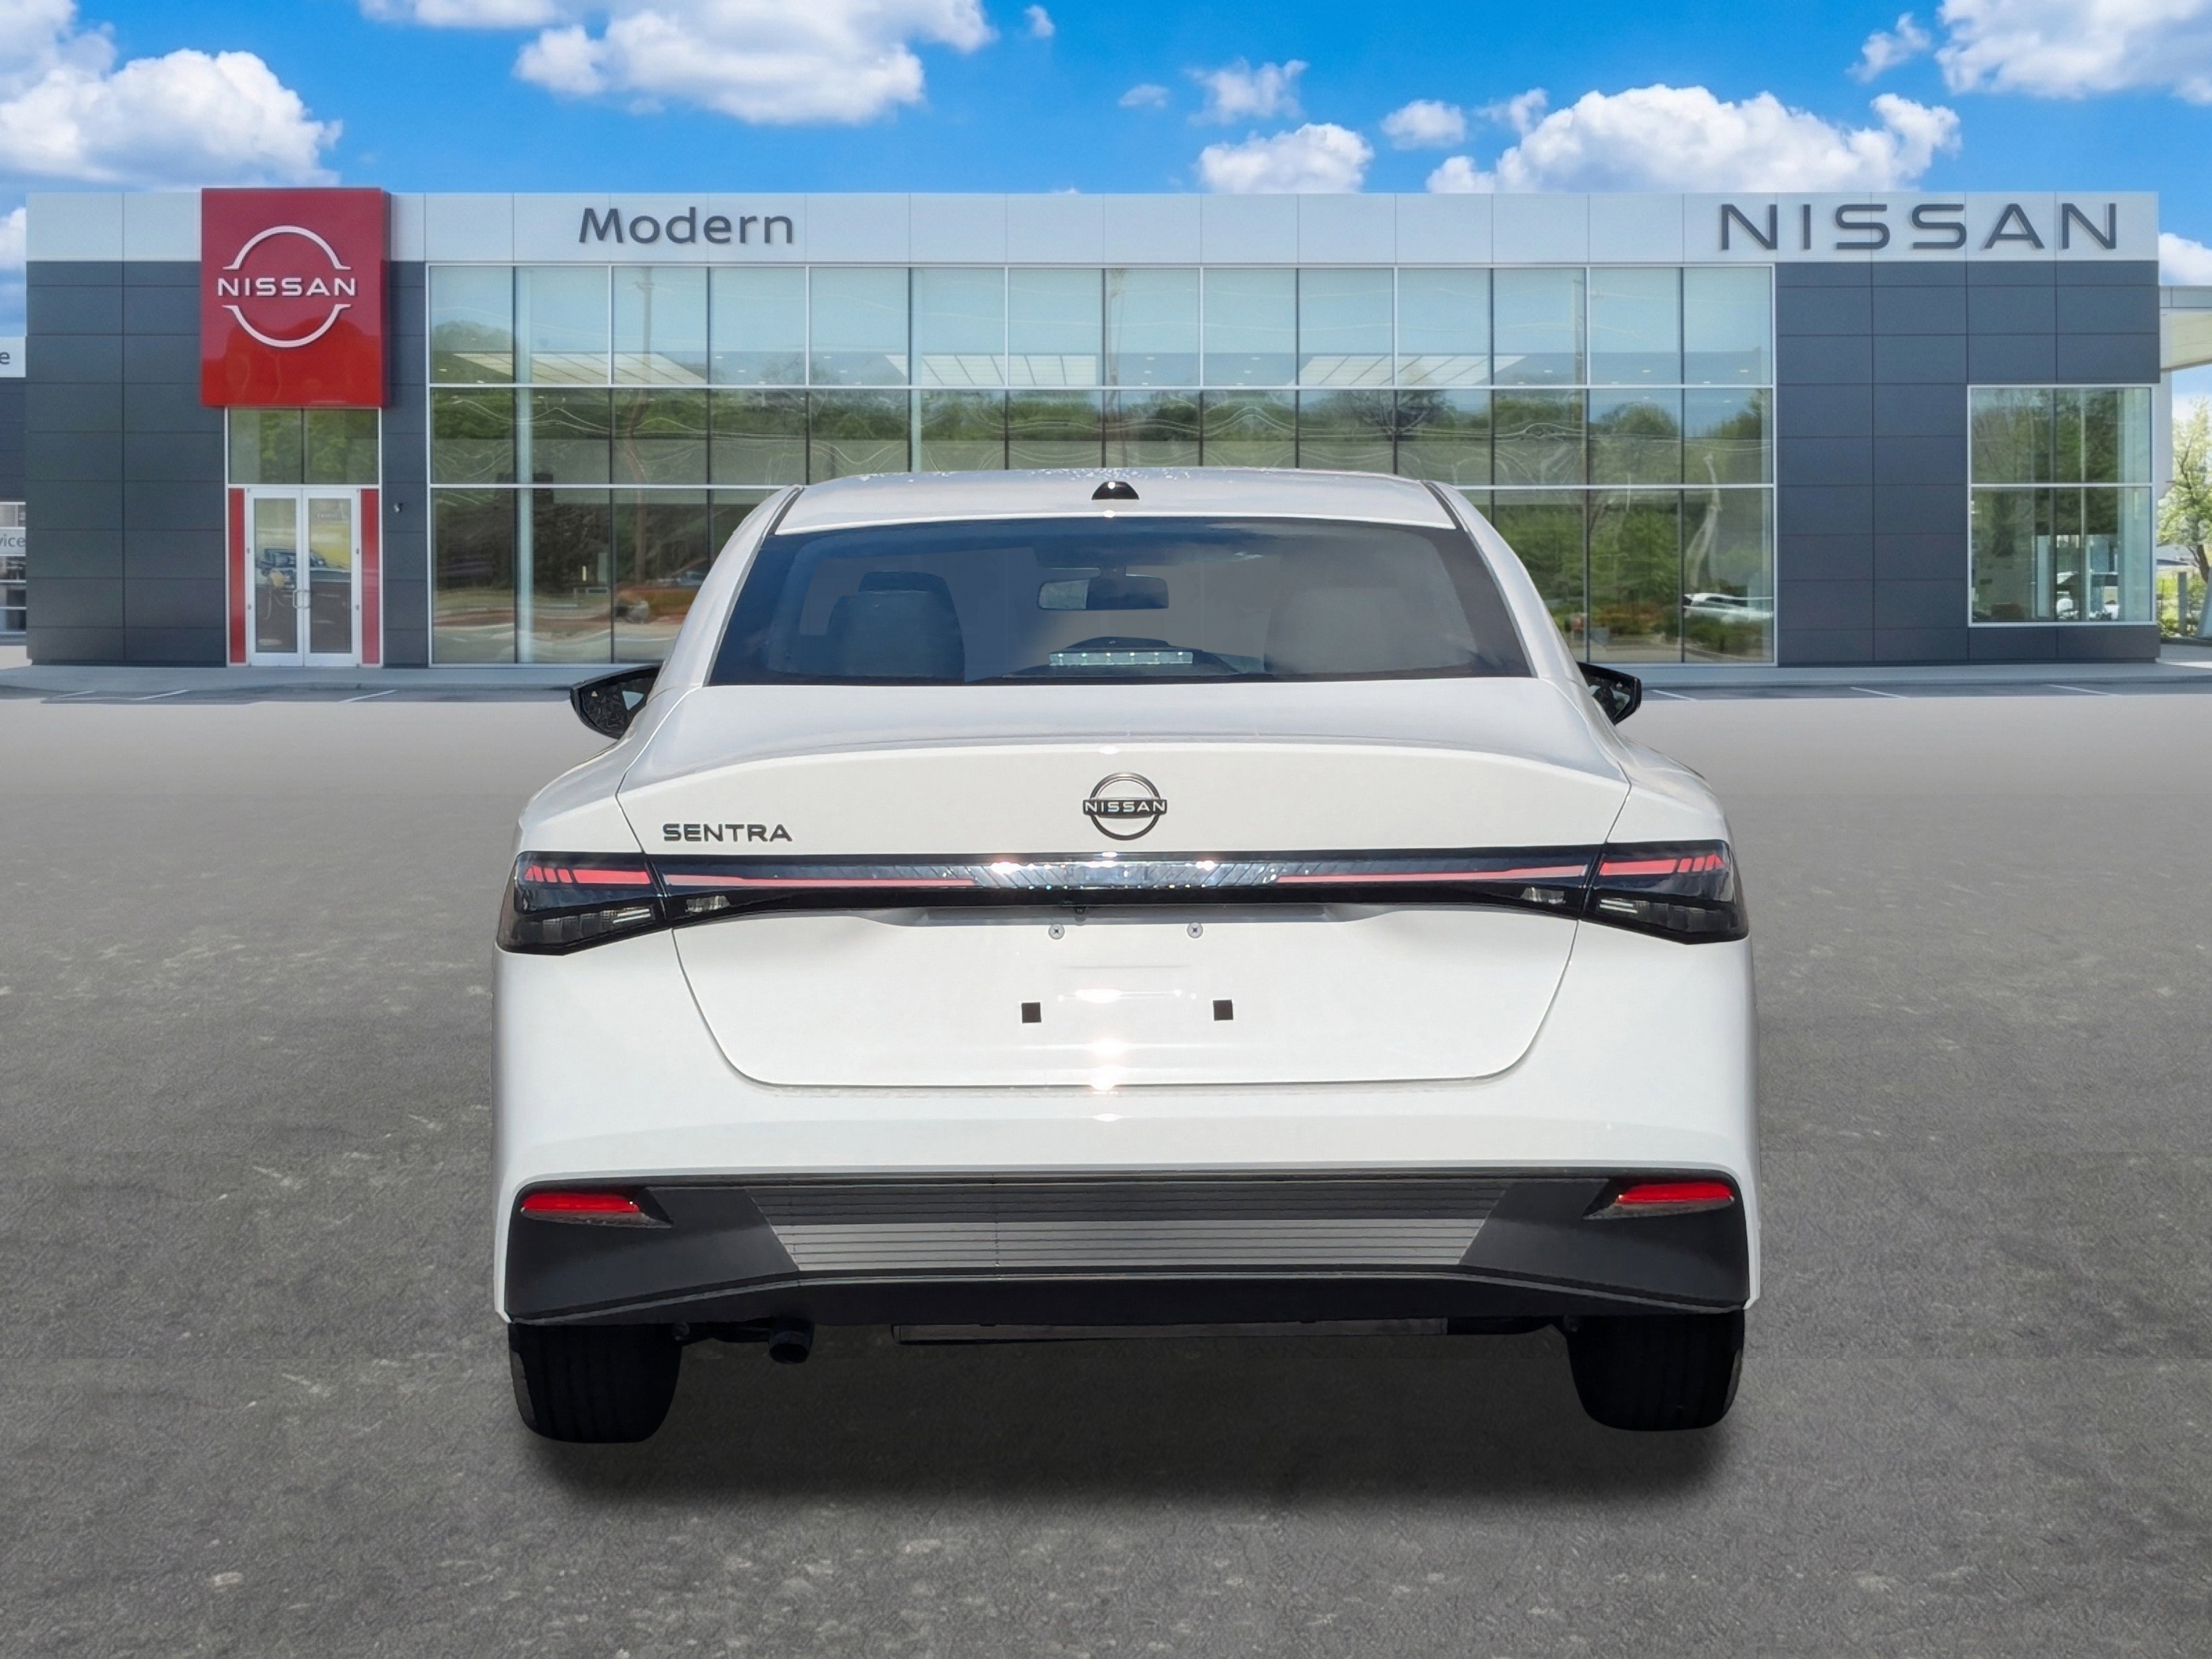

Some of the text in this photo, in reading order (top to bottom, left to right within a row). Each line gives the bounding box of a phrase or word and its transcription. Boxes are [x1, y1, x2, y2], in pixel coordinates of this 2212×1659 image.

[579, 207, 793, 244] Modern
[1719, 203, 2117, 250] NISSAN
[218, 277, 356, 297] NISSAN
[1085, 801, 1165, 812] NISSAN
[663, 823, 792, 842] SENTRA
